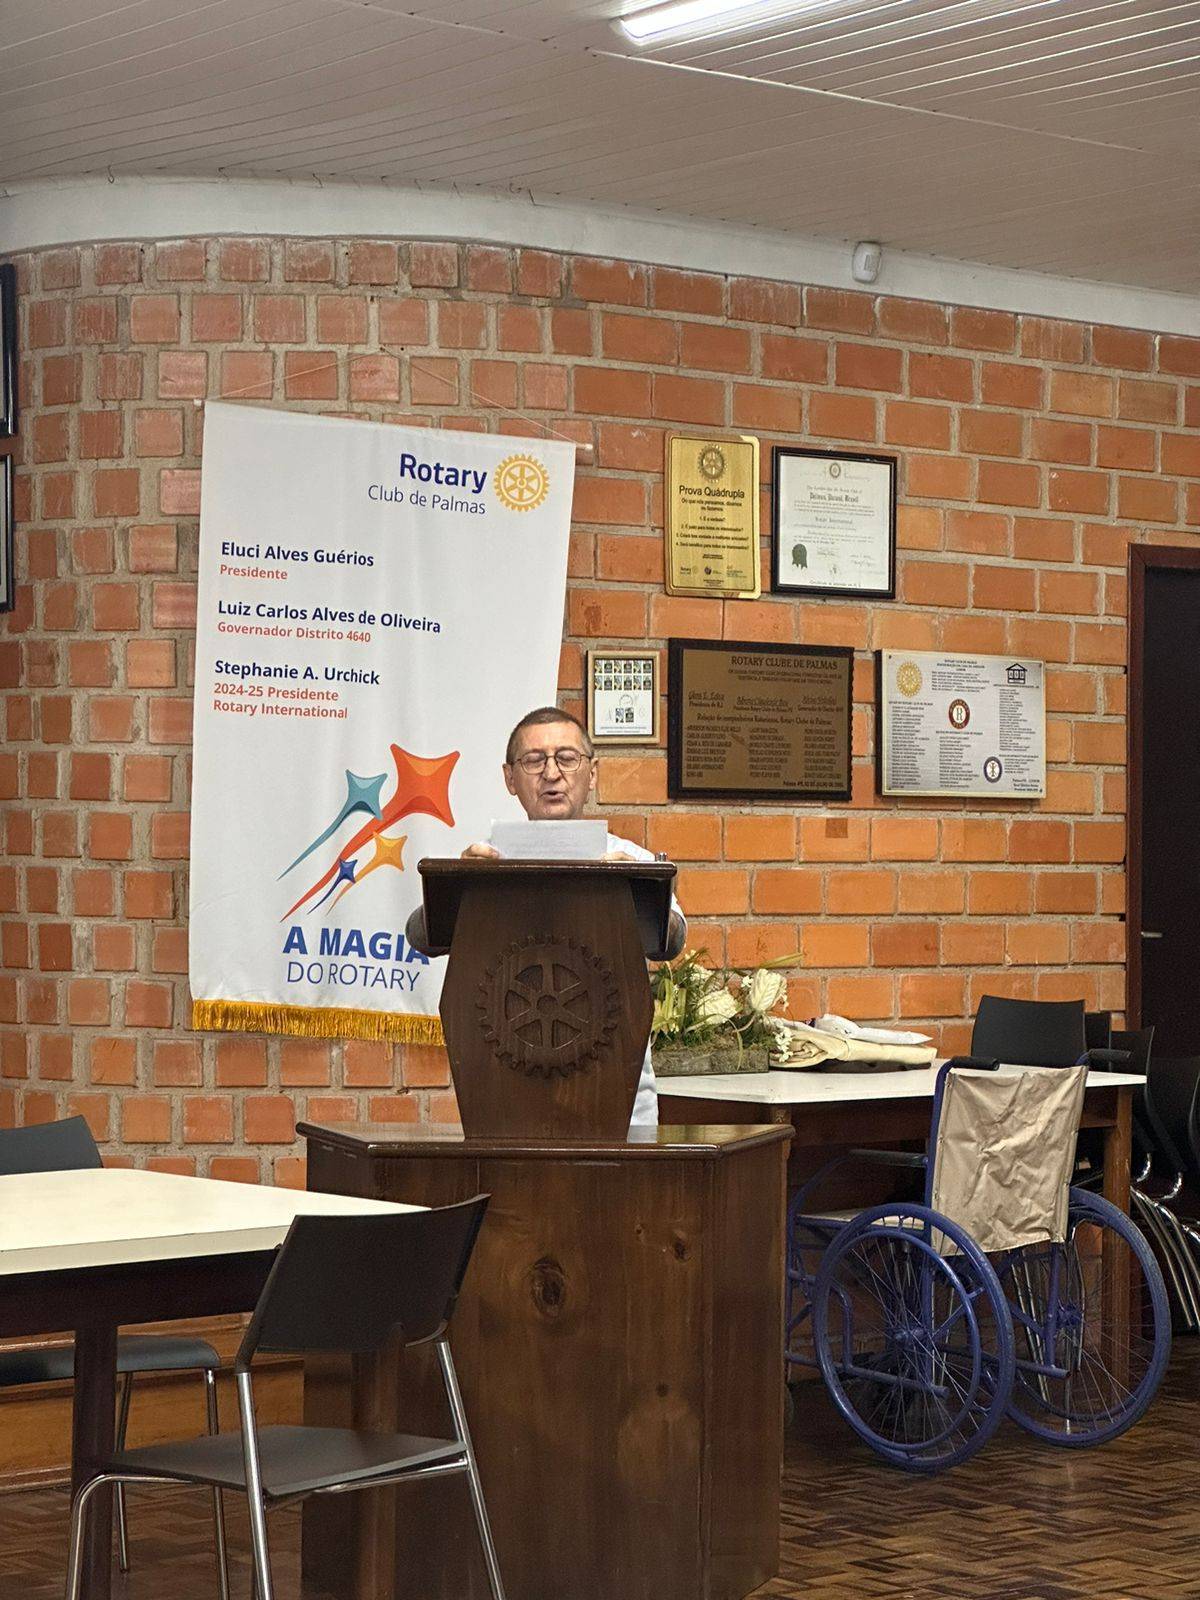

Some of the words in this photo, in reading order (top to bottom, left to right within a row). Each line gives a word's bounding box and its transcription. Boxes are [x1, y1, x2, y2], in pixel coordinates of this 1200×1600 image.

[399, 453, 488, 494] Rotary
[368, 485, 404, 503] Club
[409, 490, 427, 507] de
[432, 494, 486, 515] Palmas
[679, 484, 702, 496] Prova
[704, 486, 745, 500] Quádrupla
[221, 541, 260, 558] Eluci
[264, 546, 309, 562] Alves
[314, 549, 374, 567] Guérios
[220, 564, 288, 580] Presidente
[218, 600, 251, 616] Luiz
[256, 603, 308, 620] Carlos
[312, 607, 355, 623] Alves
[358, 610, 376, 625] de
[381, 613, 441, 633] Oliveira
[217, 621, 293, 638] Governador
[296, 627, 344, 640] Distrito
[346, 630, 371, 643] 4640
[214, 660, 299, 679] Stephanie
[303, 666, 319, 680] A.
[324, 667, 381, 685] Urchick
[731, 655, 765, 667] ROTARY
[765, 657, 792, 669] CLUBE
[793, 658, 805, 669] DE
[806, 659, 838, 670] PALMAS
[213, 682, 264, 697] 2024-25
[267, 686, 339, 701] Presidente
[213, 700, 258, 716] Rotary
[261, 703, 348, 719] International
[956, 707, 963, 721] R
[282, 926, 308, 955] A
[287, 961, 324, 985] DO
[328, 963, 420, 992] ROTARY
